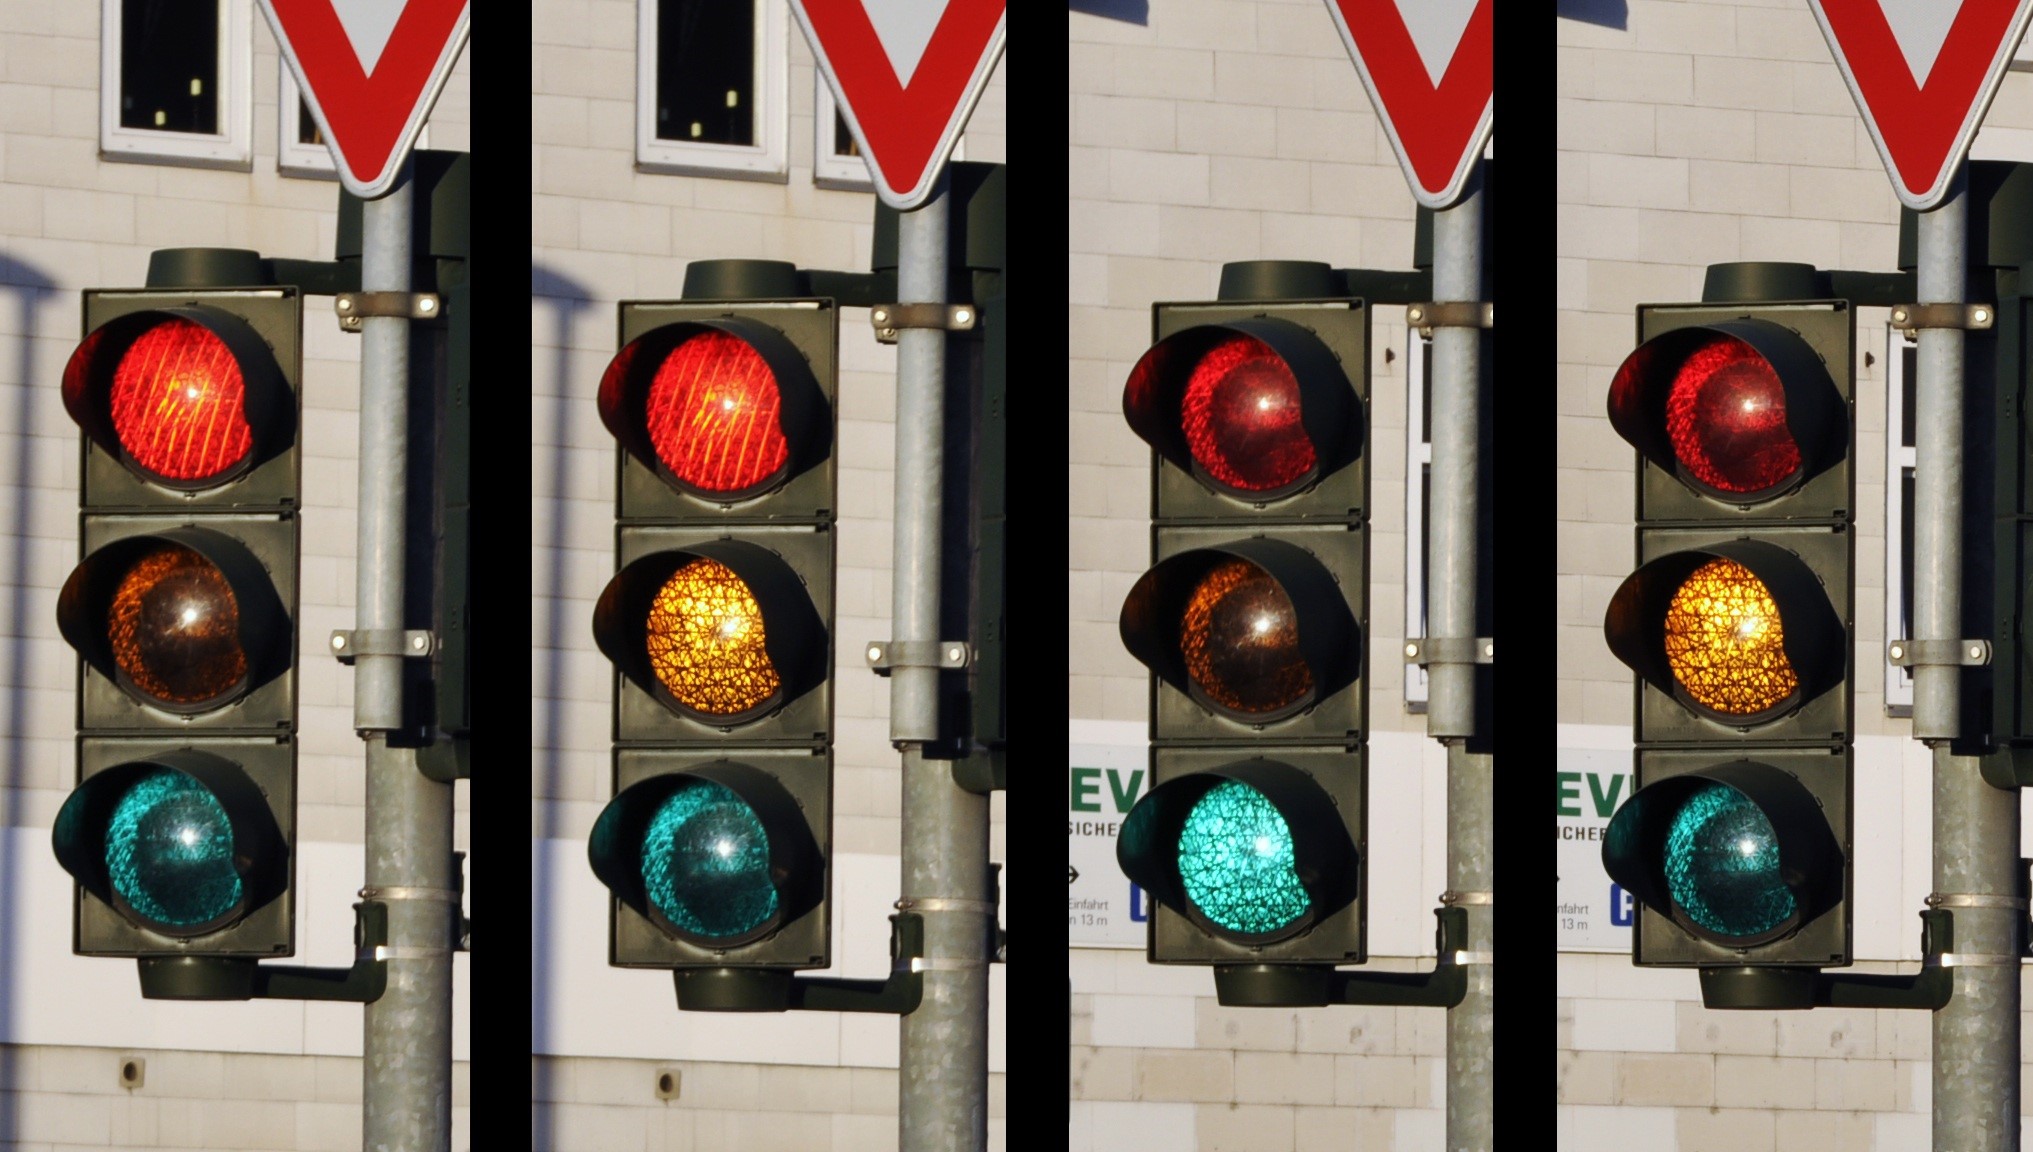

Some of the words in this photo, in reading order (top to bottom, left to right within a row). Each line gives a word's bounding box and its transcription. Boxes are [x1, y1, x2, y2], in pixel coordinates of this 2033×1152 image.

[1069, 821, 1123, 837] SICHE
[1081, 914, 1094, 926] 13
[1096, 915, 1108, 926] m
[1561, 918, 1574, 930] 13
[1577, 920, 1588, 930] m
